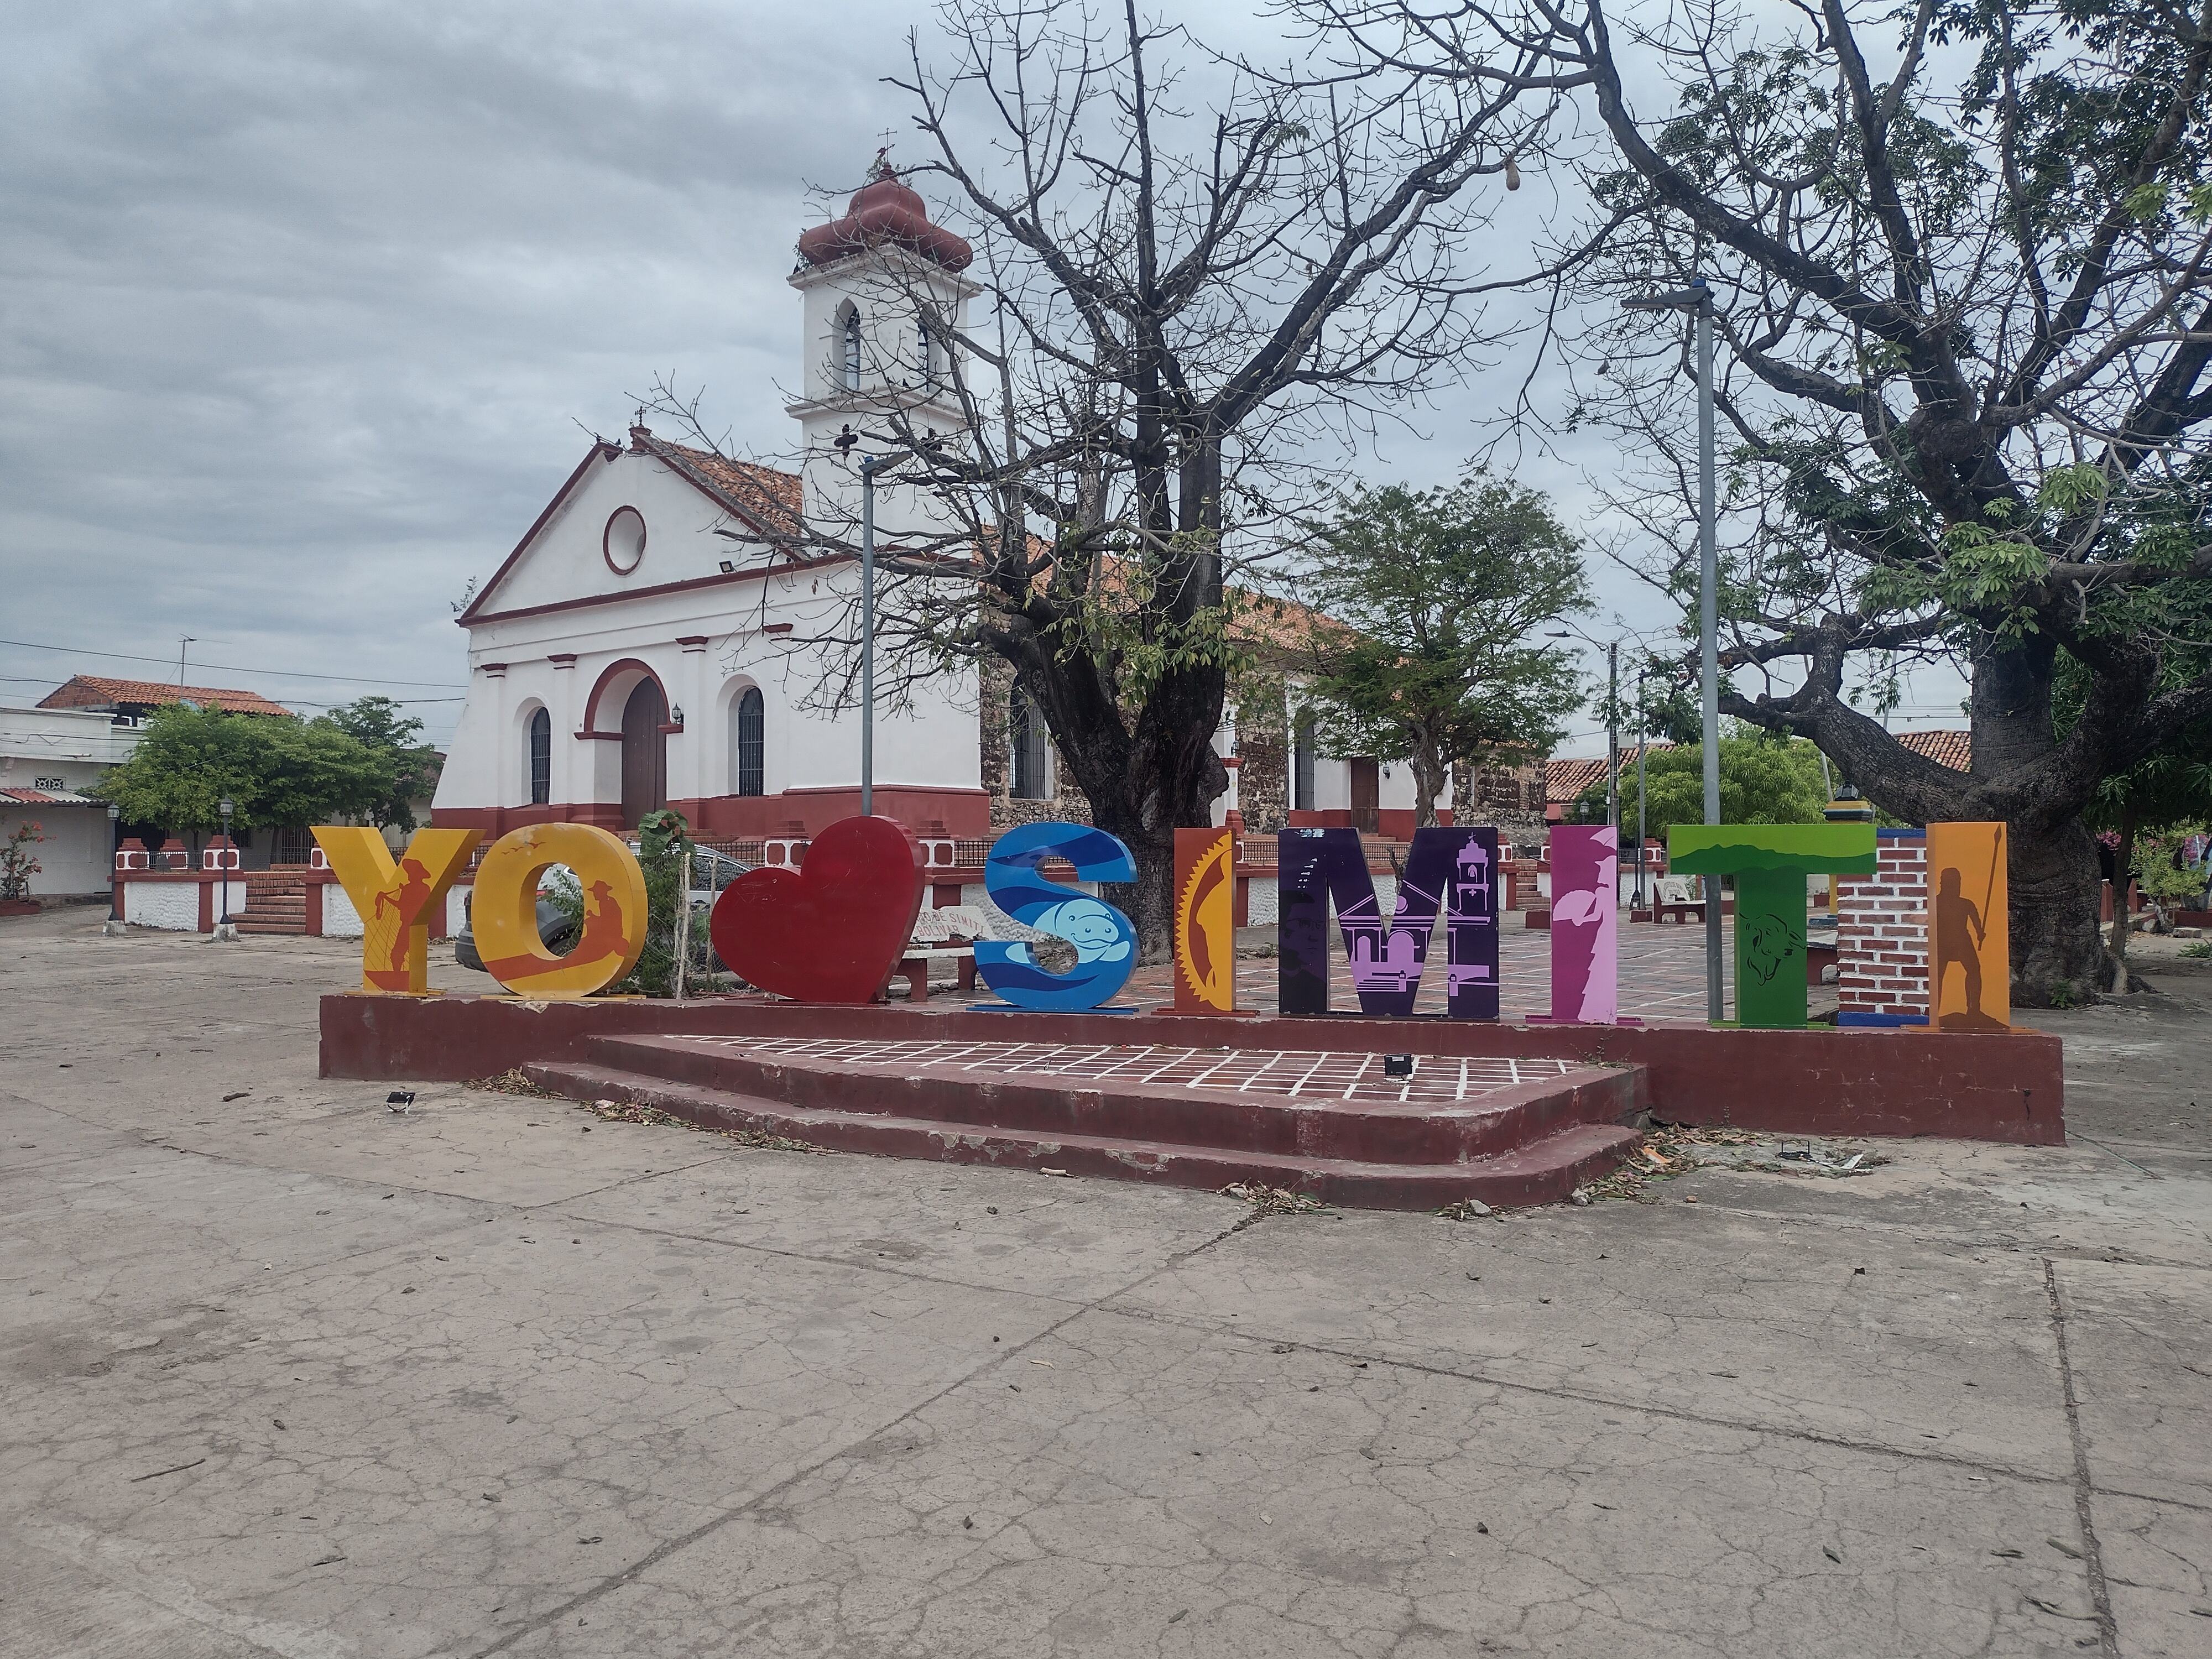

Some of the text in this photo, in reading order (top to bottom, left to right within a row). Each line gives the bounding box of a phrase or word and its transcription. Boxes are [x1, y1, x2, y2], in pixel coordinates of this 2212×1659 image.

[310, 822, 2010, 1029] YO SIMITI
[949, 913, 984, 933] SIMITI
